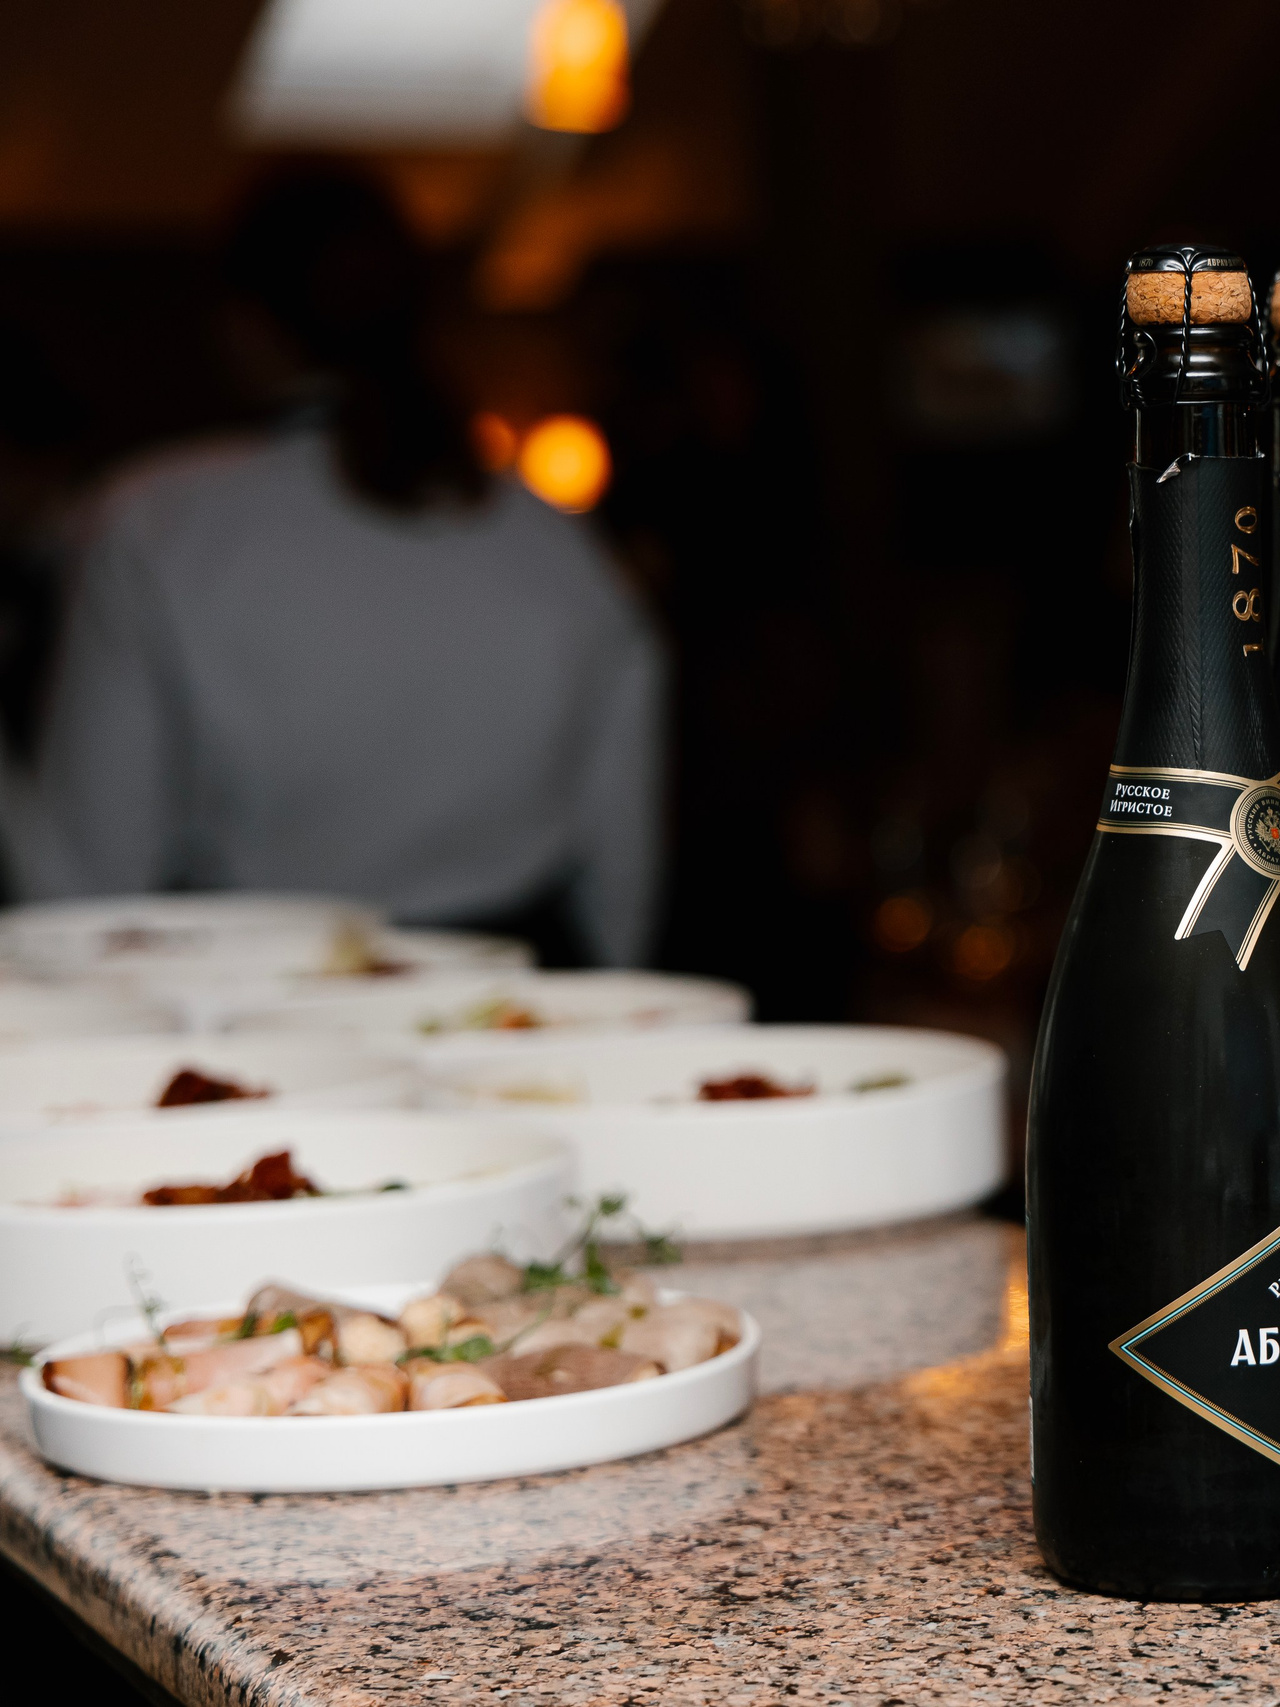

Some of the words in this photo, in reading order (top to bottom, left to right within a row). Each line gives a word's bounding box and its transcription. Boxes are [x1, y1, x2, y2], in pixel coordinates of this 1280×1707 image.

[1231, 506, 1264, 657] 1870
[1115, 783, 1171, 800] РУССКОЕ
[1110, 799, 1173, 817] ИГРИСТОЕ
